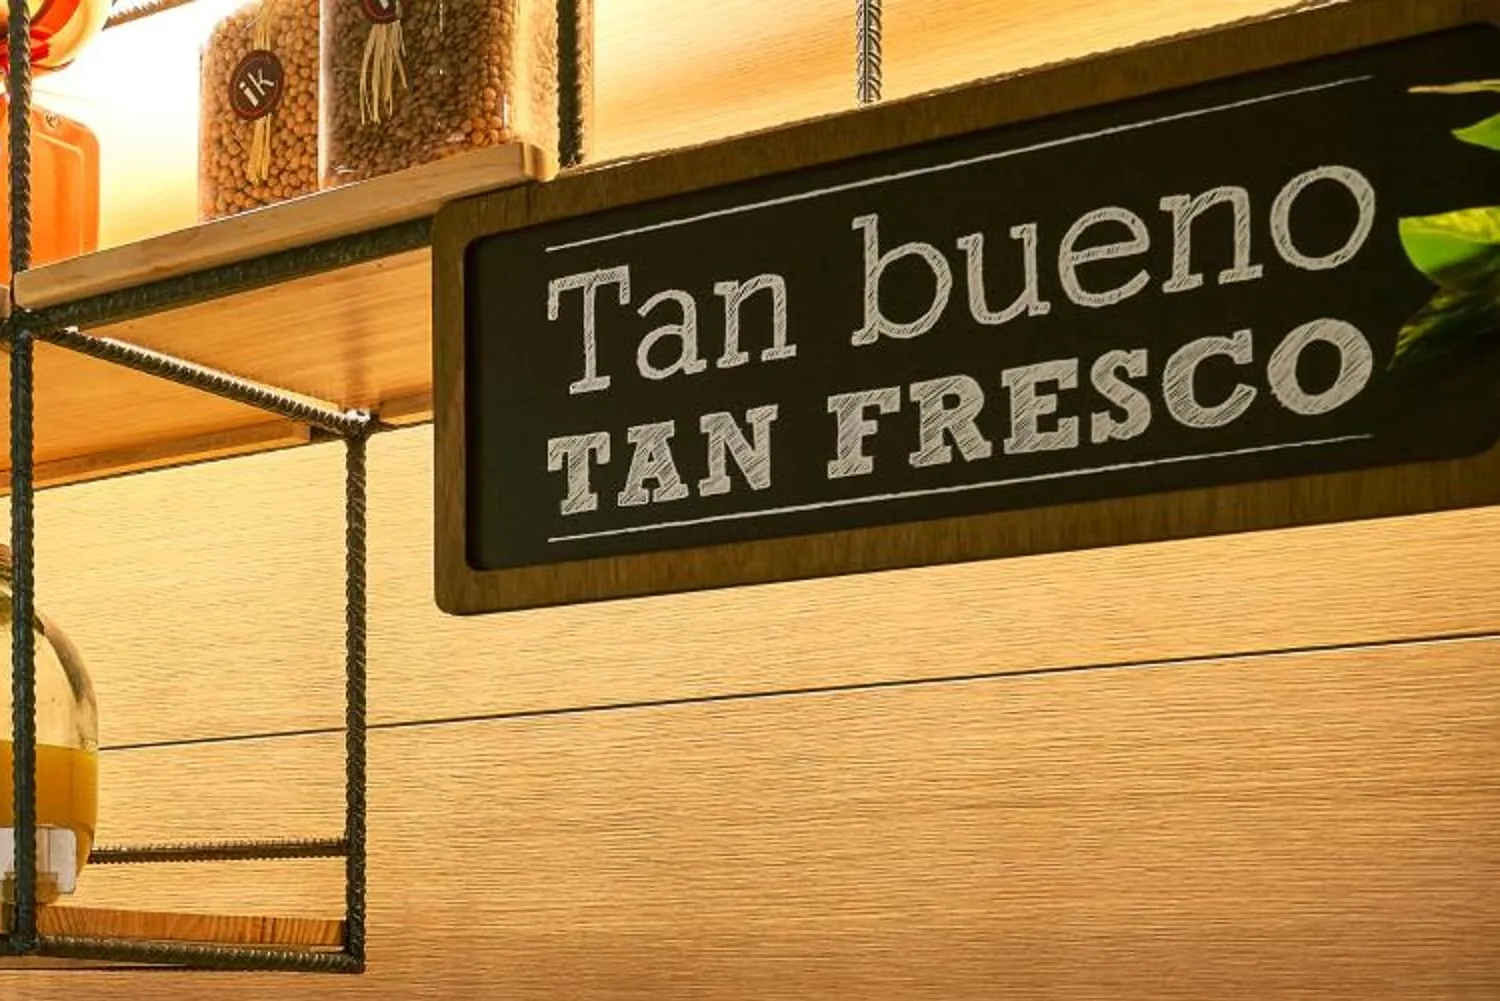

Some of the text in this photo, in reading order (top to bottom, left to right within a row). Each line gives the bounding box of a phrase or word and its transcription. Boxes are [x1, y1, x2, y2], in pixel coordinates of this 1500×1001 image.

[239, 68, 275, 107] ik
[547, 165, 1376, 394] Tan bueno
[547, 317, 1374, 516] TAN FRESCO
